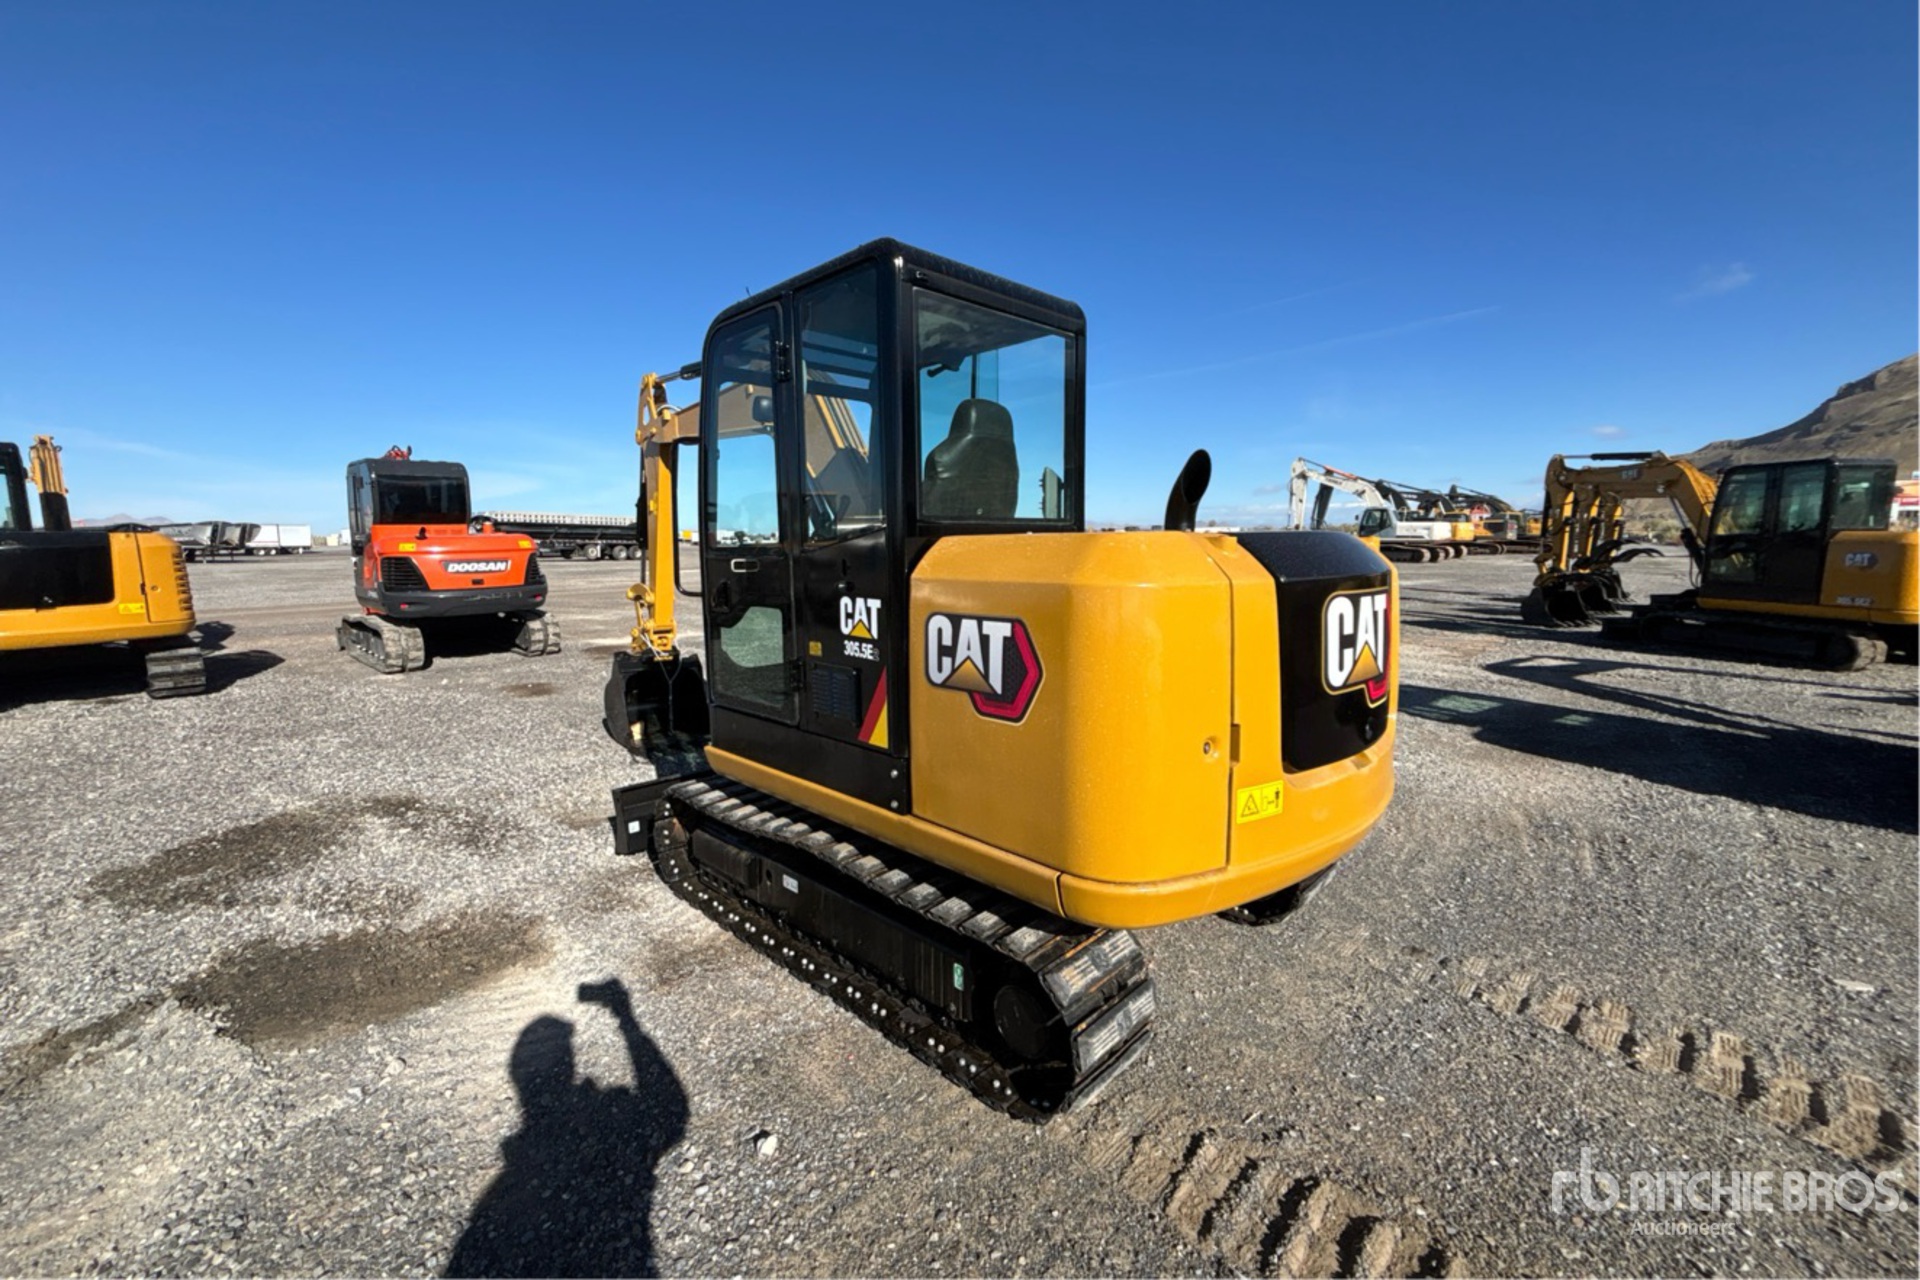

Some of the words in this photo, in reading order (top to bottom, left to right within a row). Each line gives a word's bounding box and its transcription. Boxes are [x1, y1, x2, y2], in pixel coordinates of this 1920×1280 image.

[447, 560, 507, 573] DOOSAN
[1845, 553, 1872, 567] CAT
[839, 595, 882, 640] CAT
[927, 614, 1013, 696] CAT
[1326, 593, 1388, 688] CAT
